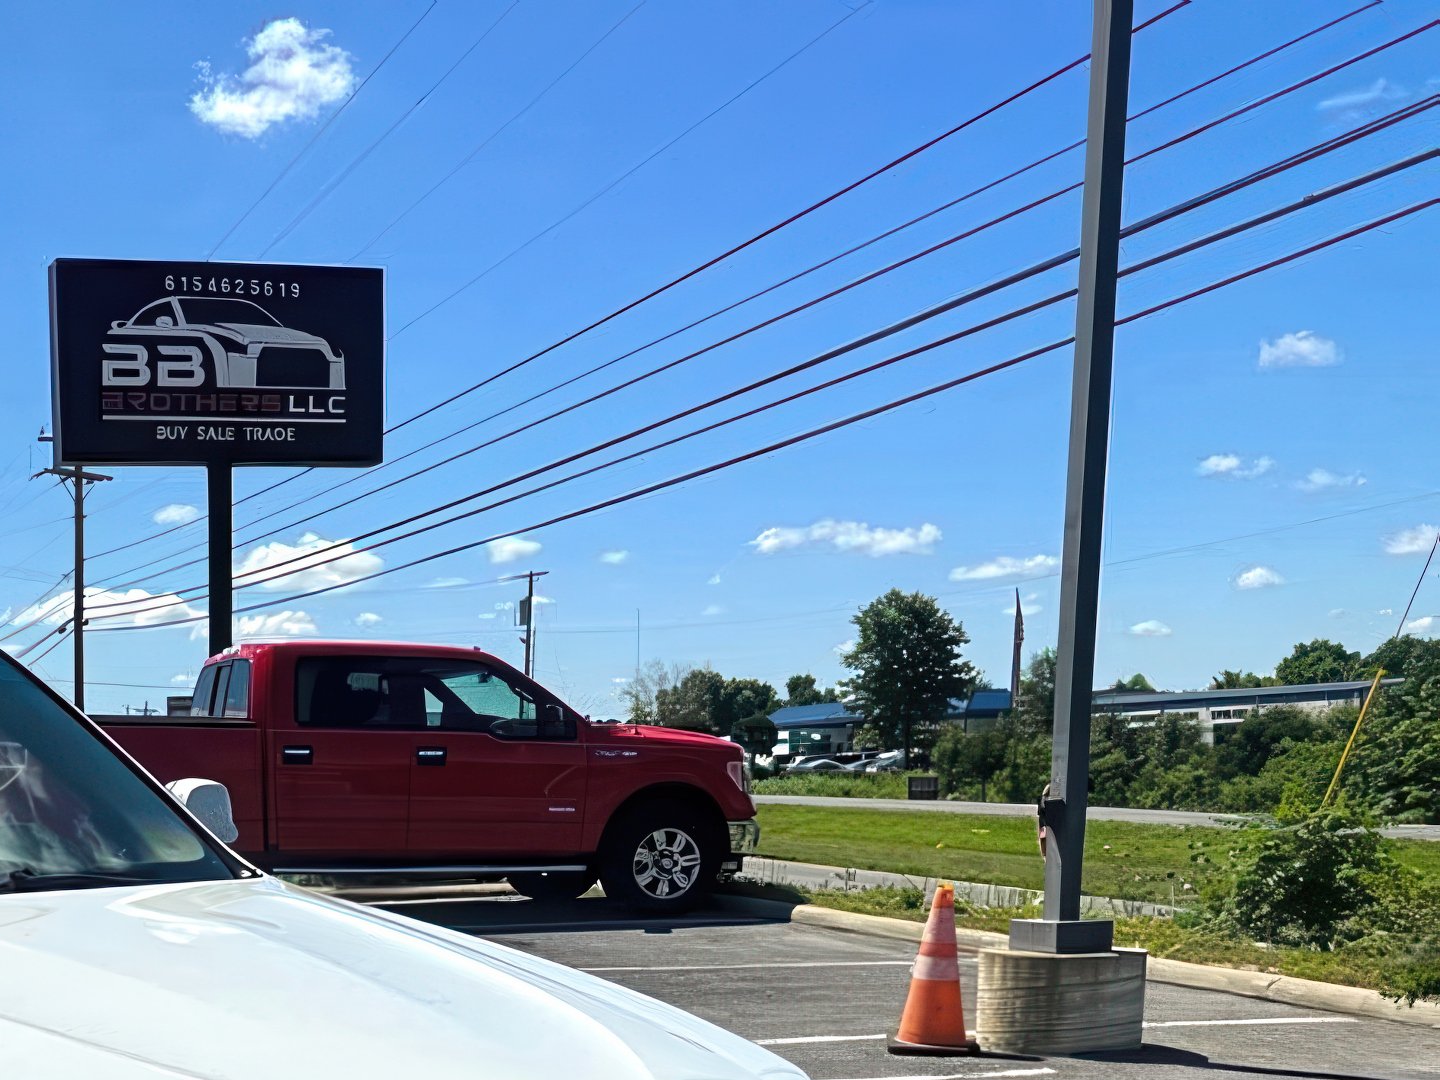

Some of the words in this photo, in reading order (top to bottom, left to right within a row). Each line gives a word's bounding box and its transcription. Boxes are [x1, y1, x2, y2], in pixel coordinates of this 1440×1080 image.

[165, 275, 300, 298] 6154625619
[102, 344, 205, 387] BB
[102, 391, 281, 412] BROTHERS
[289, 395, 347, 414] LLC
[156, 426, 188, 440] BUY
[197, 426, 235, 441] SALE
